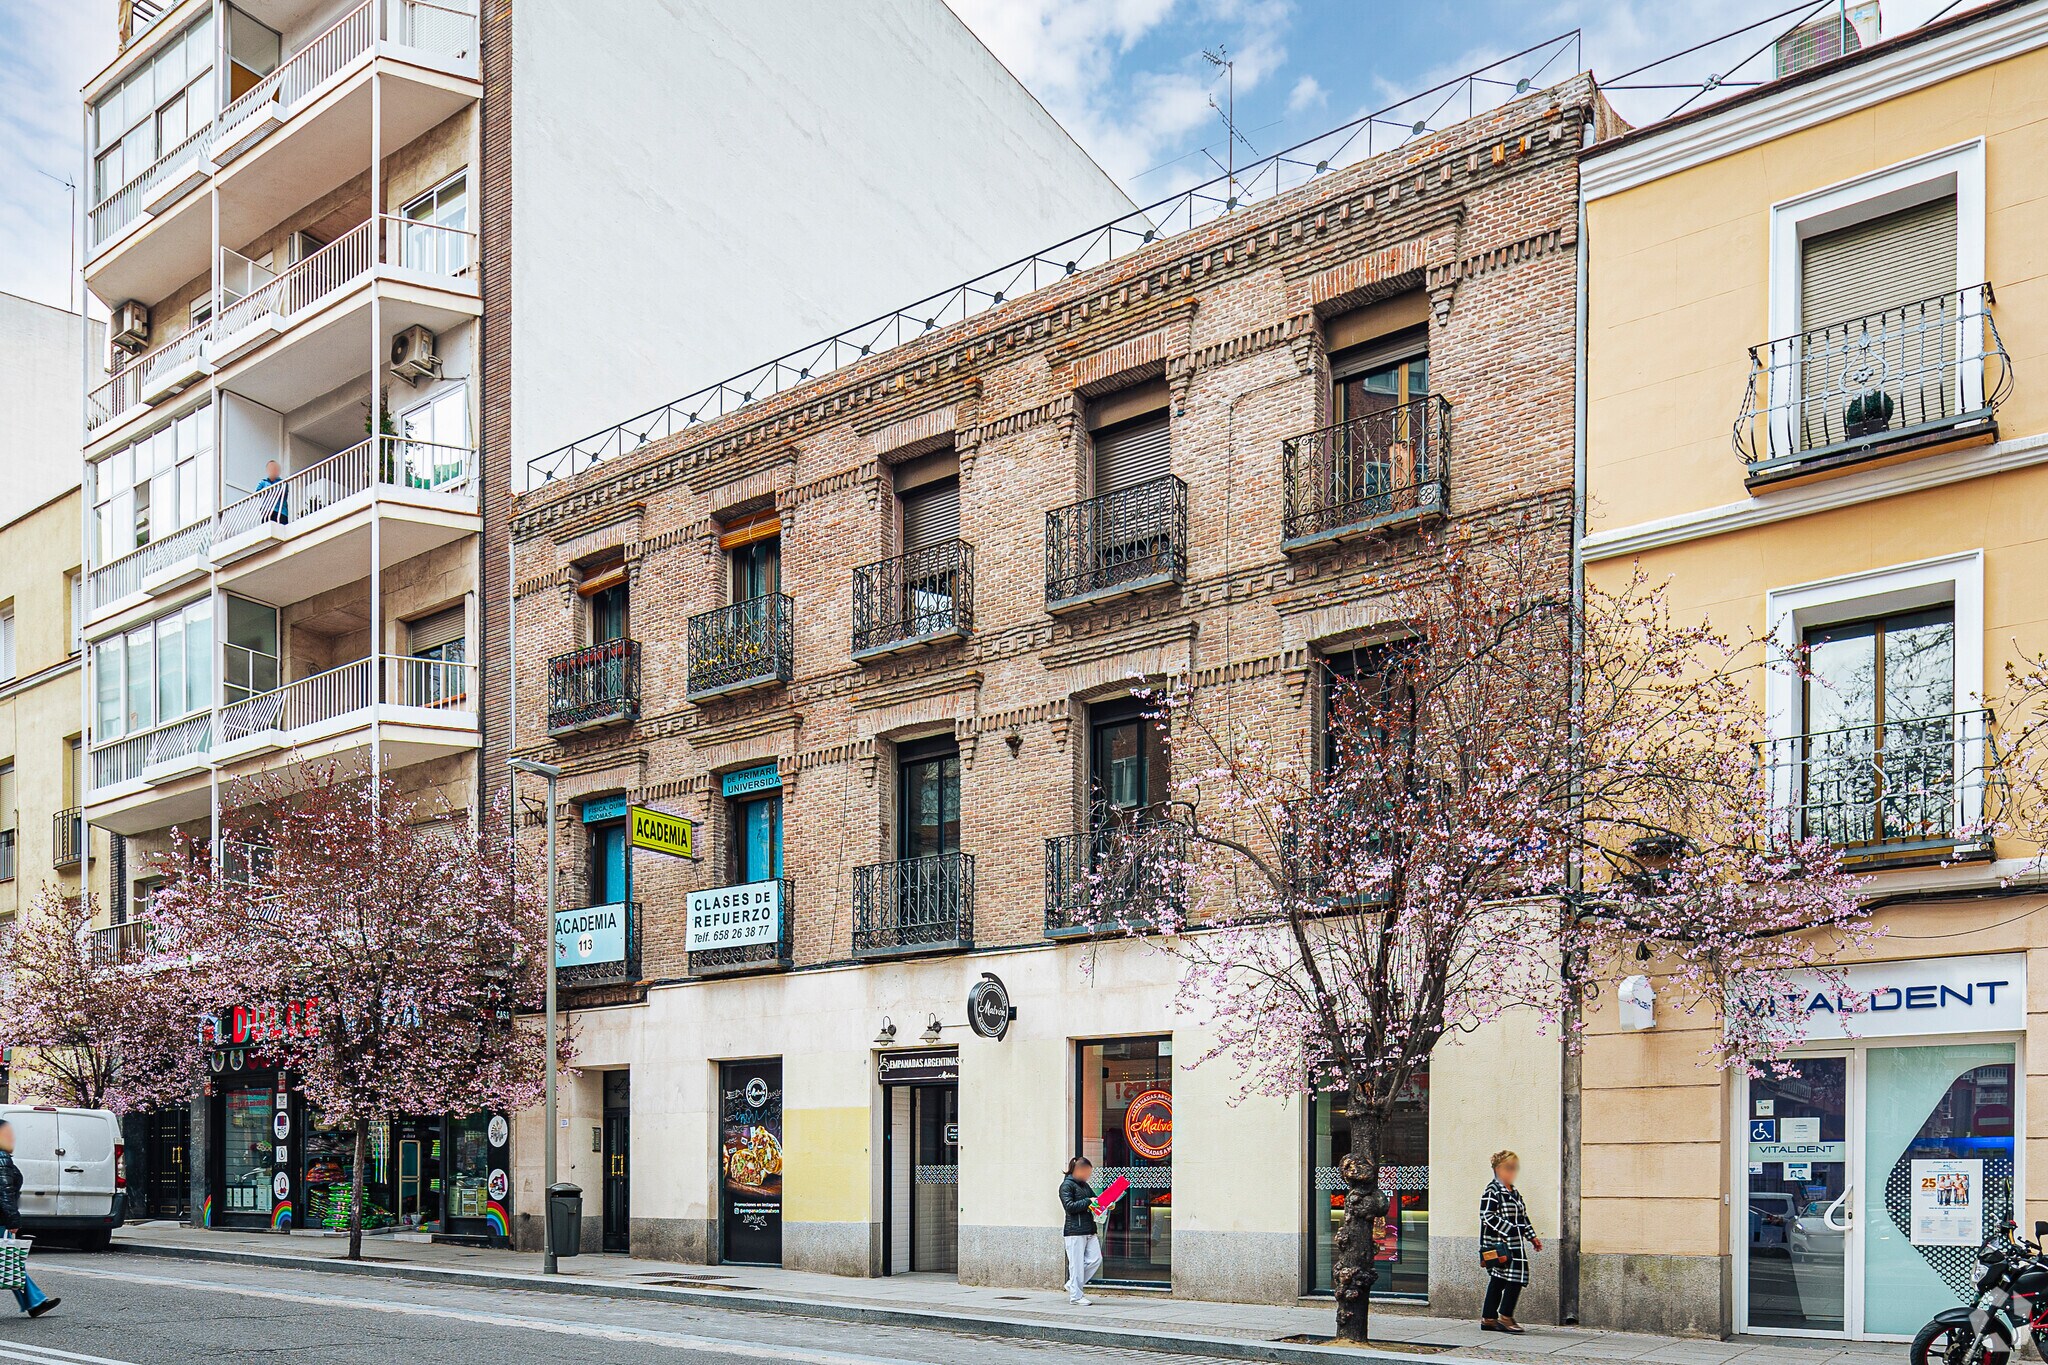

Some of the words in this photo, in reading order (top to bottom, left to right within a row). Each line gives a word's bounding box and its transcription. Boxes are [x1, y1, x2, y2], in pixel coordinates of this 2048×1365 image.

[727, 776, 737, 784] DE
[636, 816, 688, 848] ACADEMIA
[694, 893, 749, 912] CLASES
[755, 892, 770, 904] DE
[555, 912, 617, 936] ACADEMIA
[694, 907, 771, 929] REFUERZO
[694, 931, 711, 943] Telf.
[713, 929, 730, 942] 658
[732, 928, 743, 939] 26
[745, 926, 756, 938] 38
[758, 924, 770, 936] 77
[578, 939, 593, 952] 113
[889, 1059, 924, 1069] EMPANADAS
[924, 1056, 959, 1068] ARGENTINAS
[1759, 1145, 1835, 1154] VITALDENT
[1921, 1177, 1937, 1189] 25
